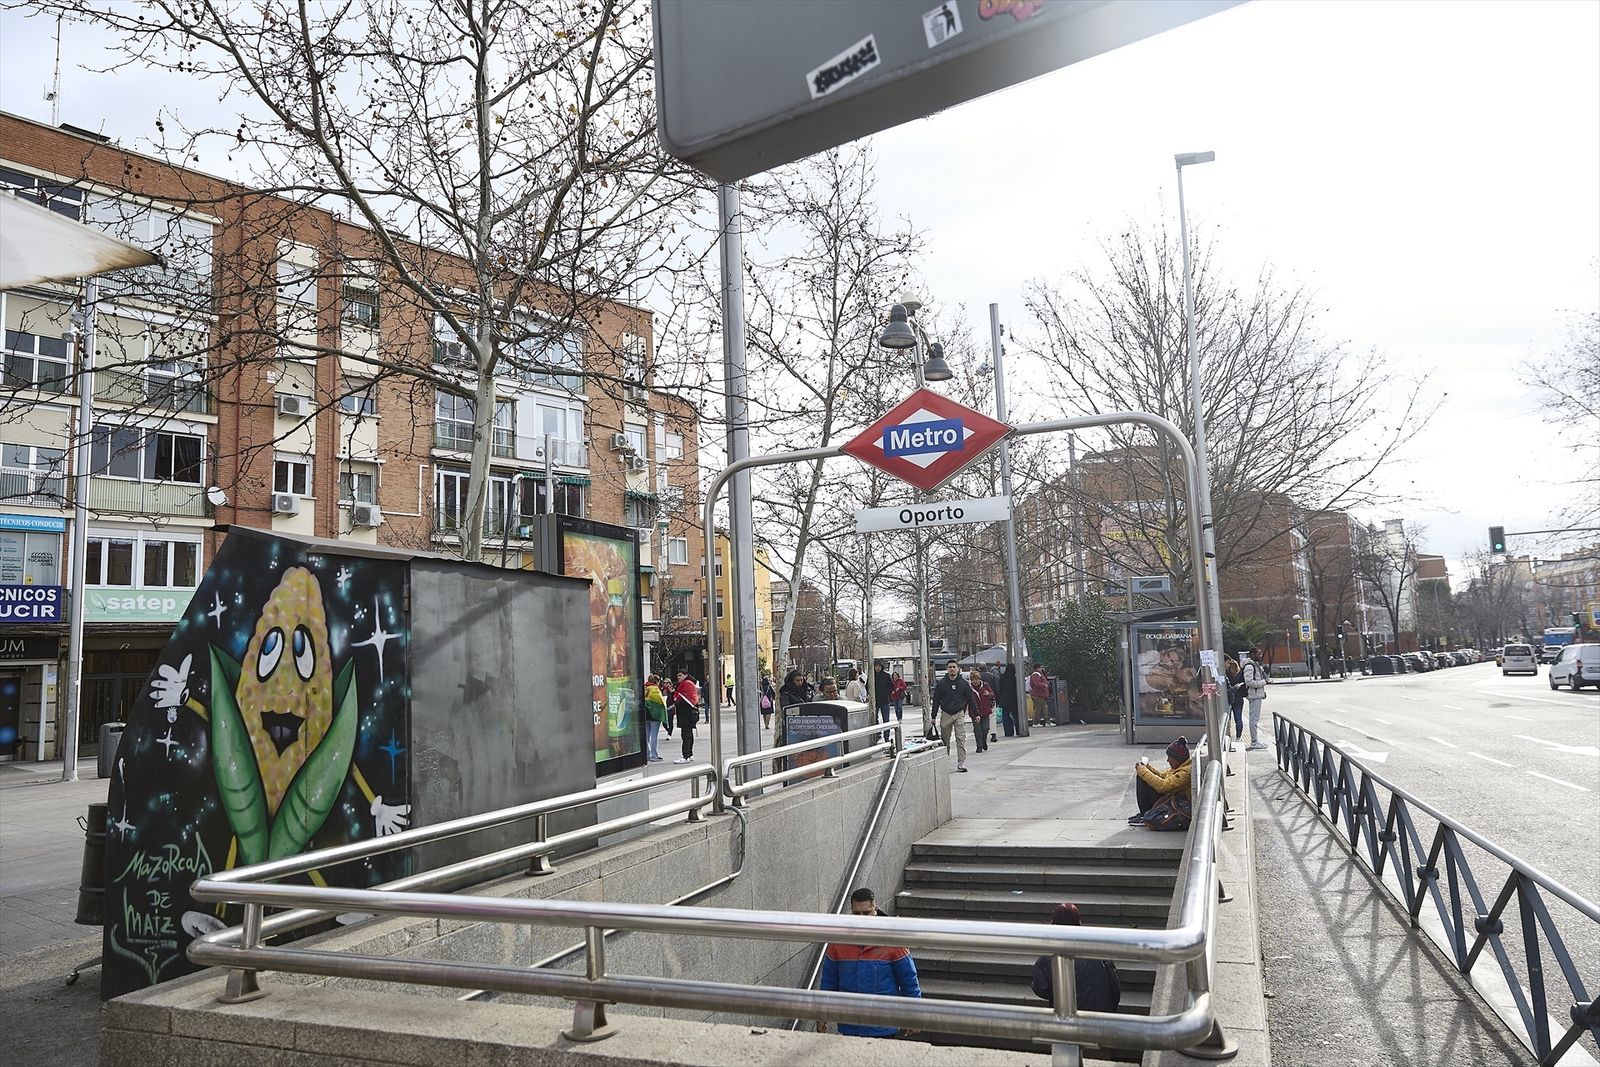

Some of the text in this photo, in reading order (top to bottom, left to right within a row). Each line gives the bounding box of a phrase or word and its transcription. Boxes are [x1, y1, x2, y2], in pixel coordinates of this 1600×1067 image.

[890, 427, 957, 450] Metro
[31, 519, 64, 529] CONDUCIR
[899, 507, 964, 525] Oporto
[106, 594, 177, 614] satep
